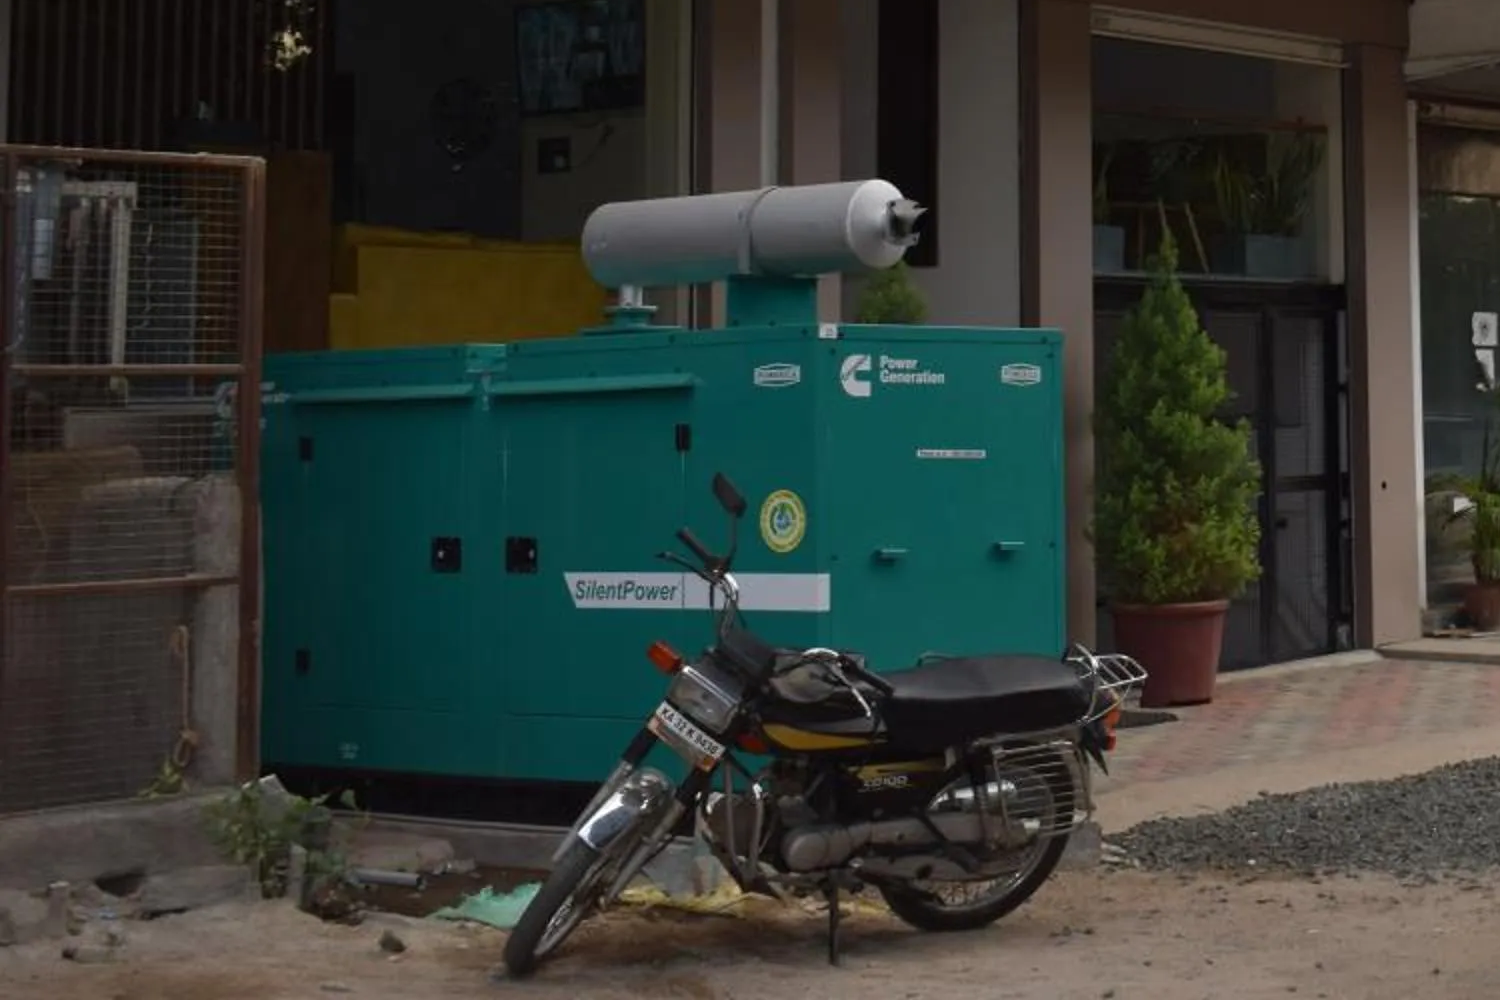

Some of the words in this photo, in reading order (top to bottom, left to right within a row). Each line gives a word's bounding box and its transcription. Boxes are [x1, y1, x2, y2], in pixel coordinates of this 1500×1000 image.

[879, 355, 918, 370] Power
[879, 369, 946, 385] Generation
[575, 580, 678, 601] SilentPower
